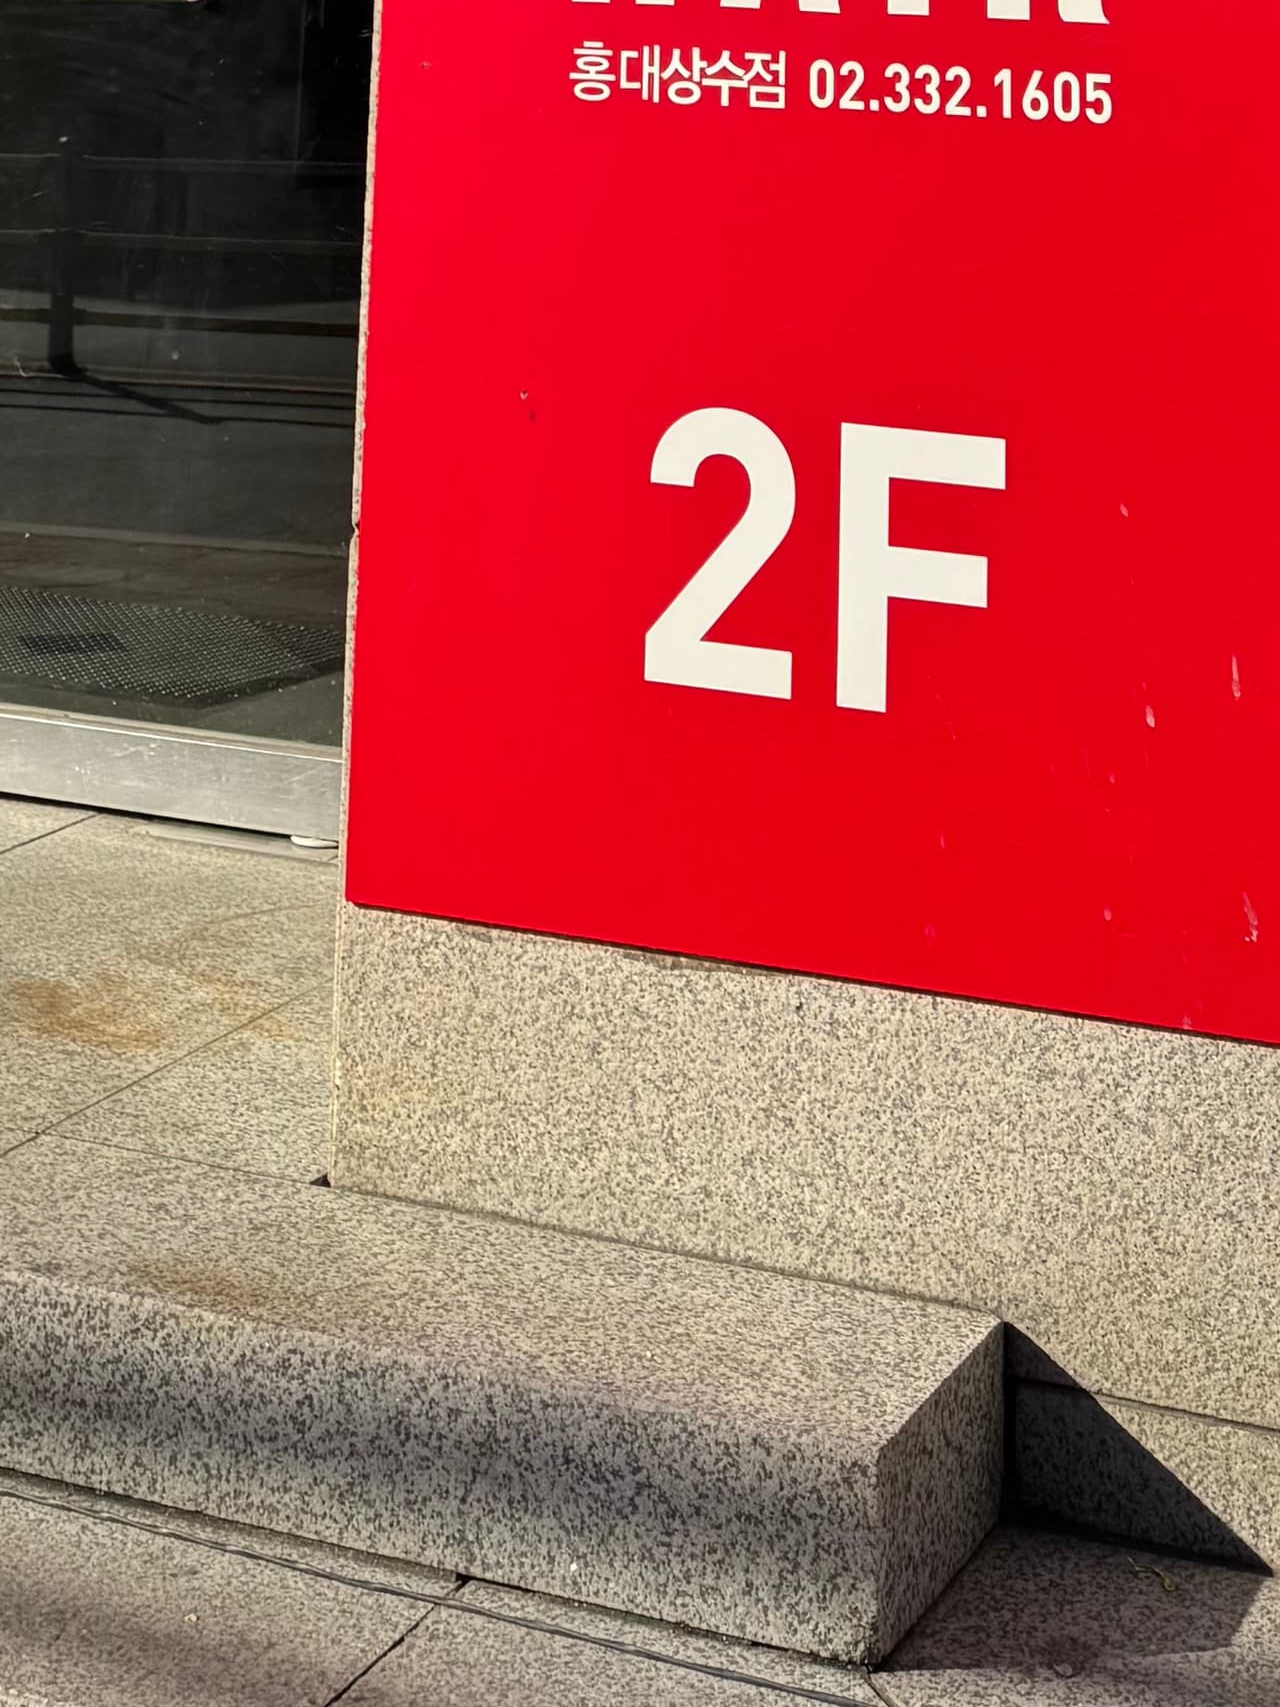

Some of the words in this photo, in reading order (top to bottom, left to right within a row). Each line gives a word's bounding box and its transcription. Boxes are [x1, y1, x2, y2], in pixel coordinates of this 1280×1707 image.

[567, 40, 788, 111] 홍대상수점
[807, 59, 1114, 126] 02.332.1605
[643, 406, 1008, 715] 2F
